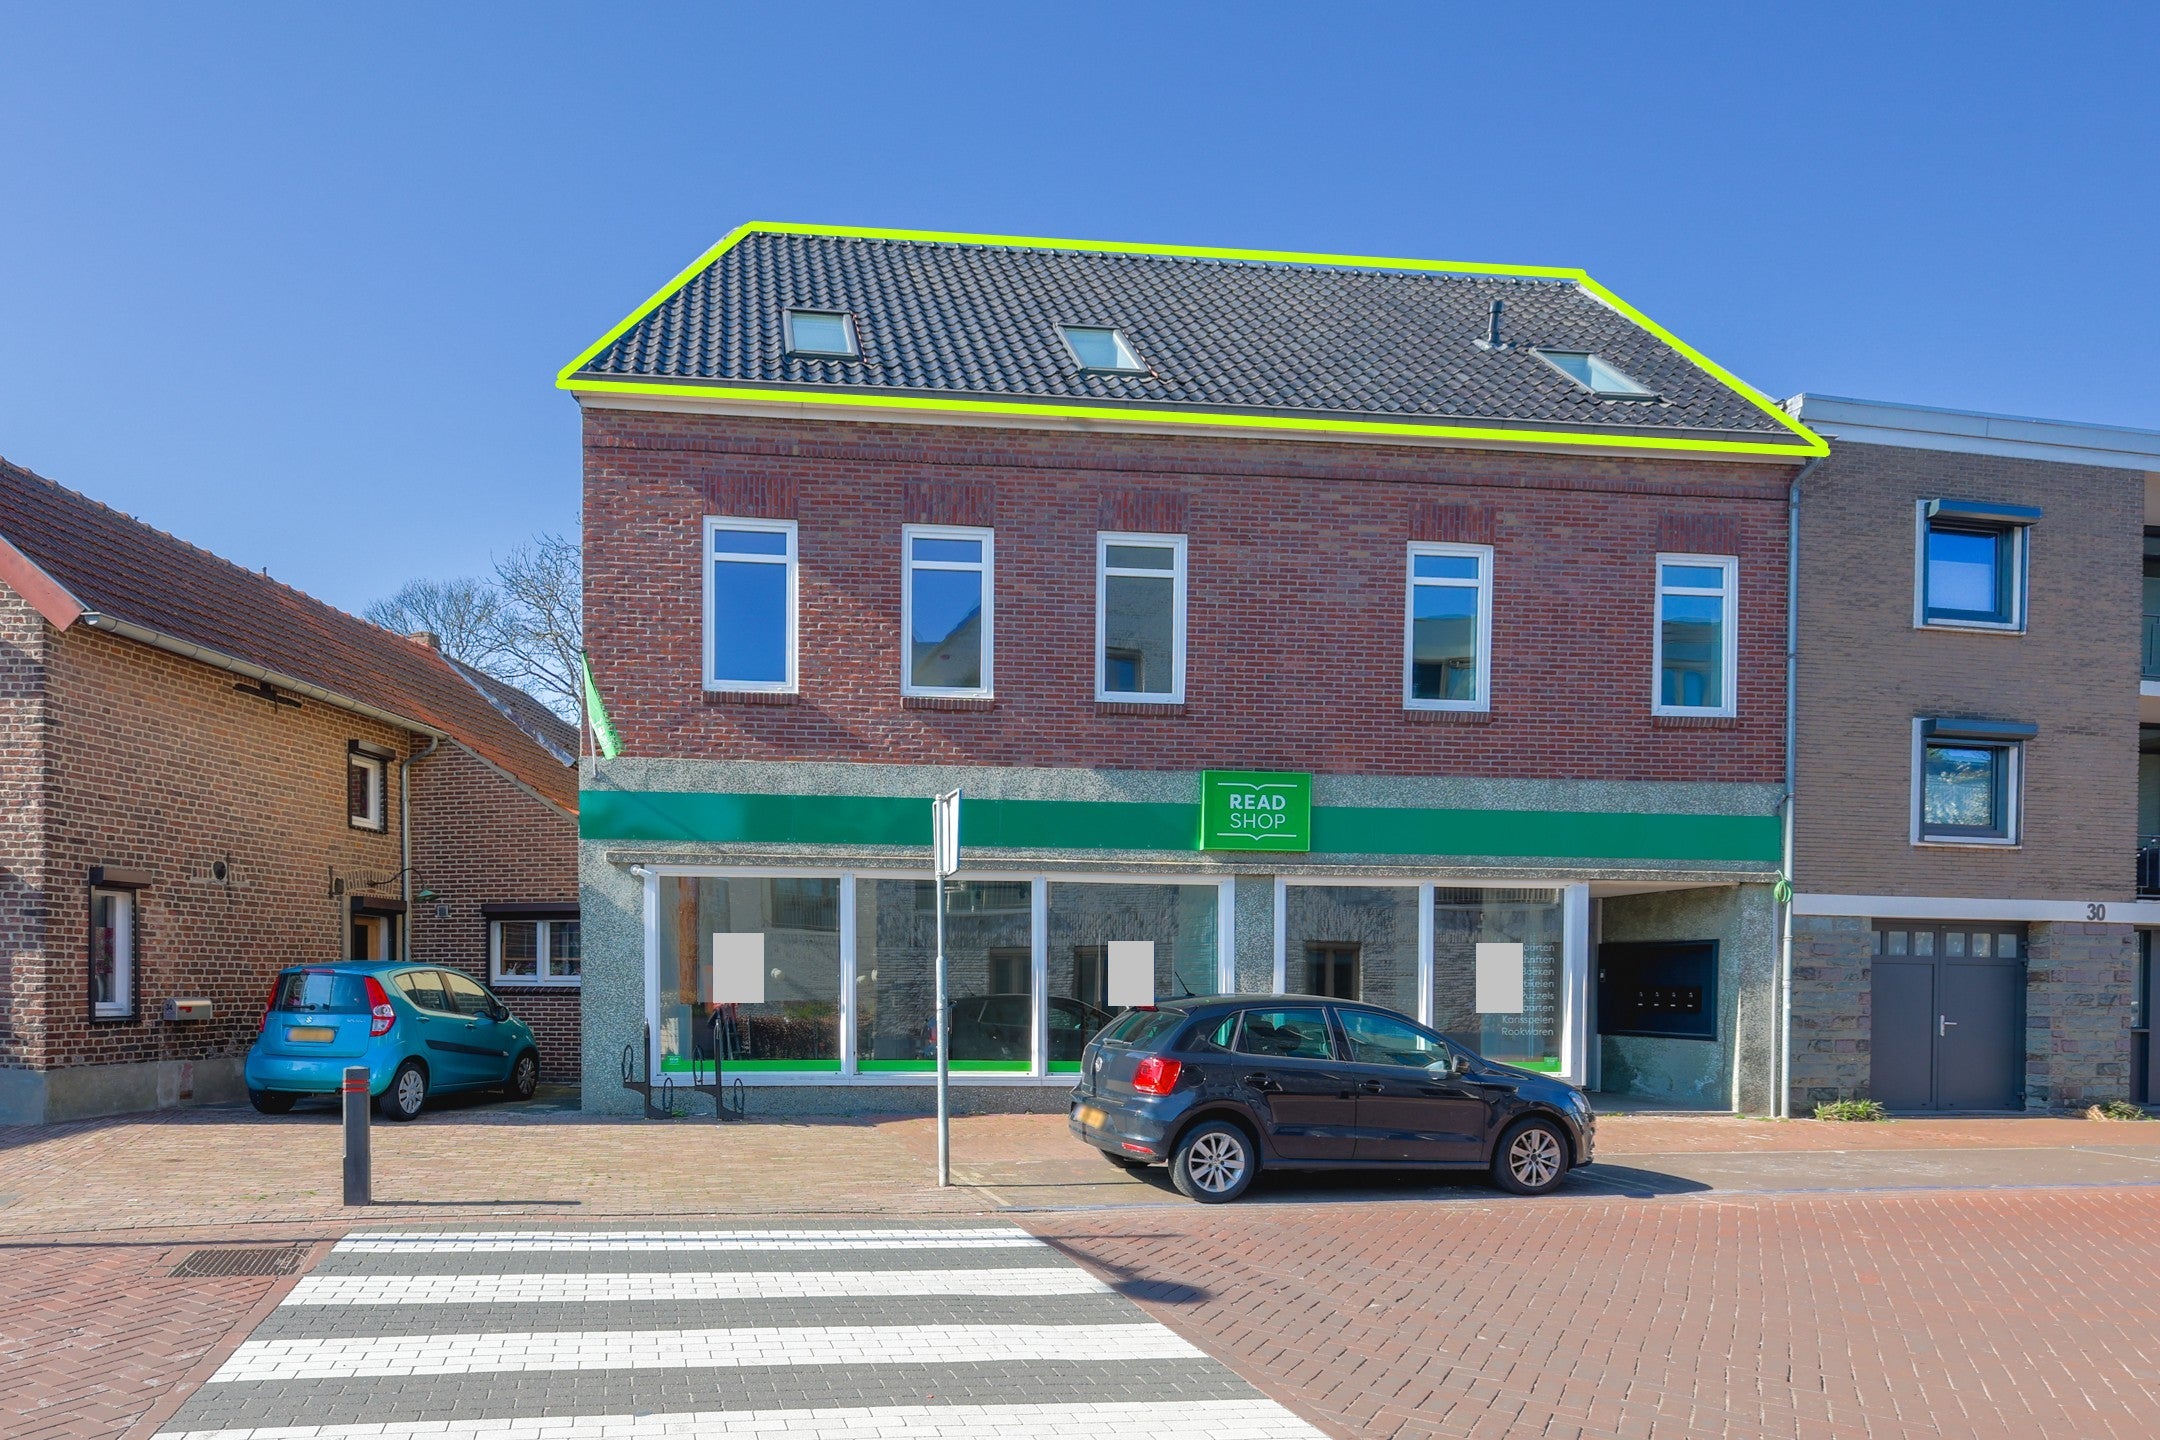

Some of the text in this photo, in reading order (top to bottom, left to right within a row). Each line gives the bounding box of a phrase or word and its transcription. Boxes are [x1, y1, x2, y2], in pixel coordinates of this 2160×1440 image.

[1229, 794, 1286, 810] READ
[1230, 812, 1286, 829] SHOP
[2086, 903, 2106, 921] 30
[1523, 944, 1555, 952] aarten
[1523, 1004, 1554, 1012] aarten
[1501, 1027, 1554, 1036] Rookwaren
